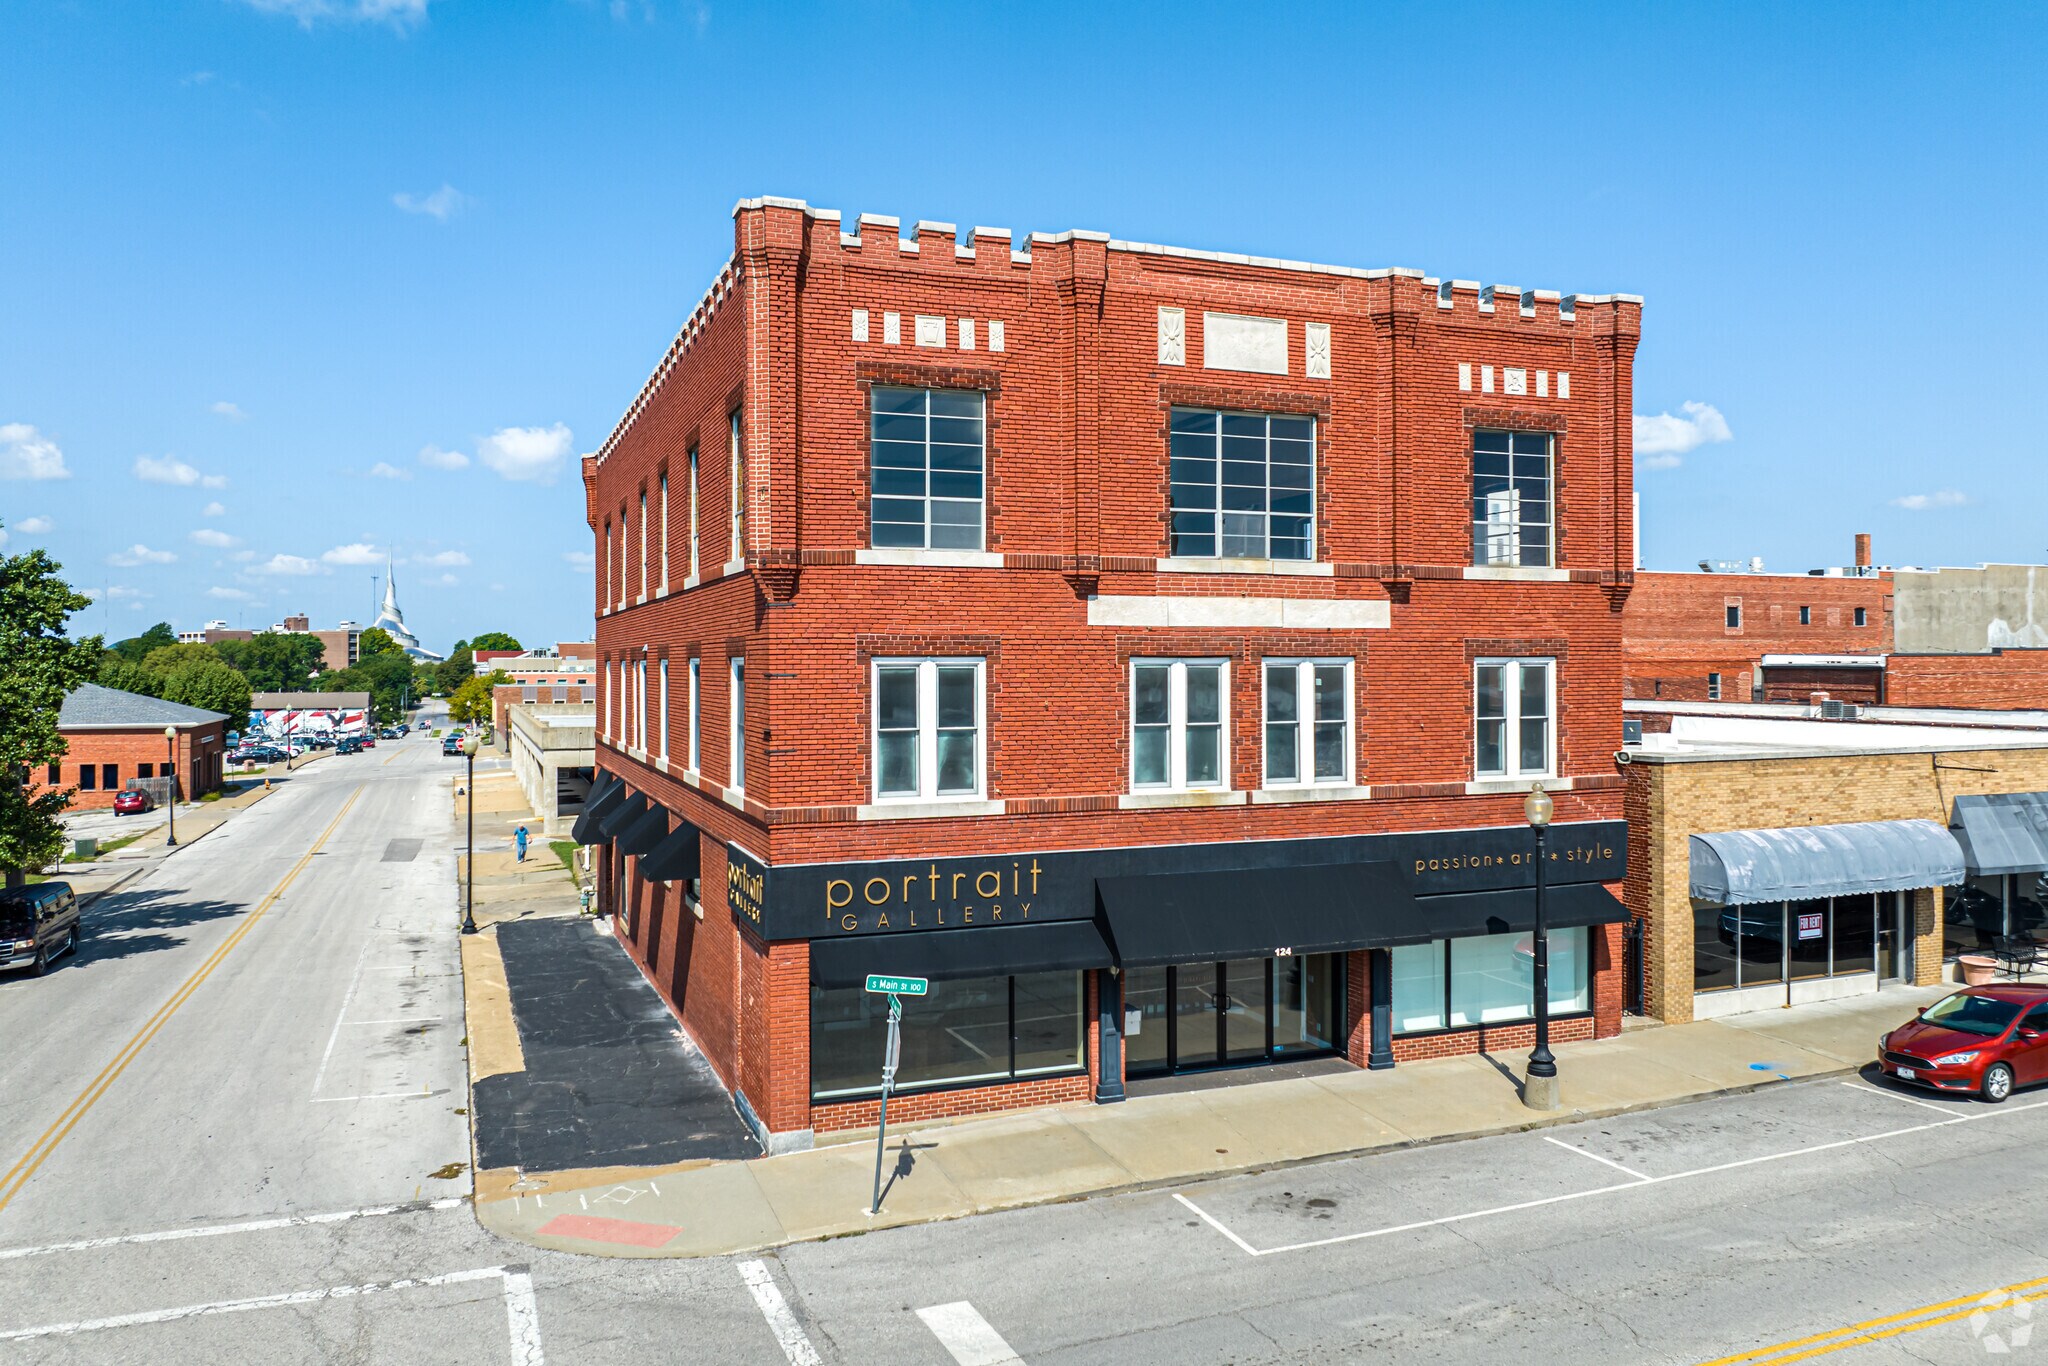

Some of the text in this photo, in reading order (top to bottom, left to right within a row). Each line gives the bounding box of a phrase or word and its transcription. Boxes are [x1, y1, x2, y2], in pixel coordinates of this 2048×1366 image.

[1415, 843, 1613, 875] passion ar style
[728, 861, 763, 905] portrait
[826, 858, 1042, 919] portrait
[841, 902, 1031, 931] GALLERY
[1800, 916, 1820, 929] FOR RENT
[1274, 946, 1292, 957] 124
[879, 979, 898, 990] Main
[900, 982, 907, 991] St
[910, 983, 921, 992] 100
